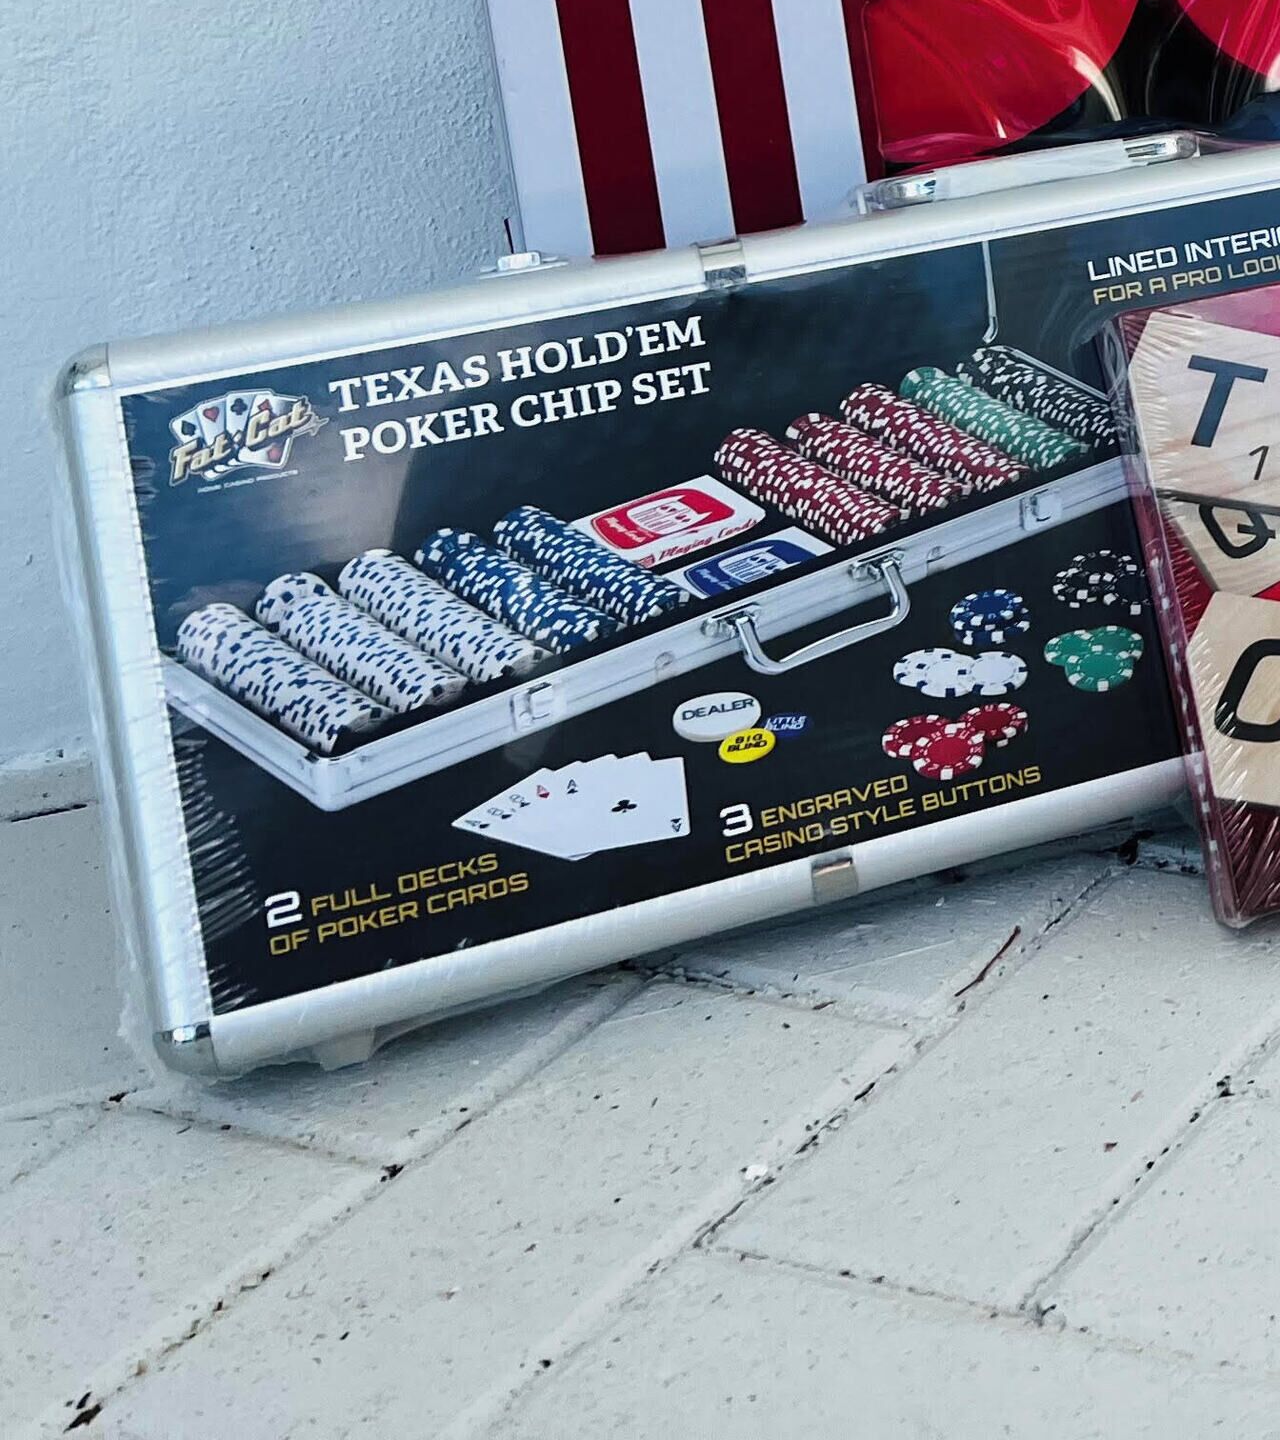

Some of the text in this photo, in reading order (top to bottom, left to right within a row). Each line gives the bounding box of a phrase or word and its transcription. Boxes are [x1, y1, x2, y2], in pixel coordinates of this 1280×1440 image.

[1087, 246, 1178, 281] LINED
[1093, 281, 1144, 305] FOR
[1149, 277, 1167, 294] A
[1172, 266, 1223, 291] PRO
[328, 315, 706, 412] TEXAS HOLD'EM
[340, 361, 712, 462] POKER CHIP SET
[1188, 354, 1269, 448] T
[171, 398, 313, 483] Fat Cat
[659, 517, 758, 560] Playing Cards
[682, 698, 754, 721] DEALER
[734, 733, 763, 745] BIG
[727, 740, 768, 753] BLIND
[720, 774, 908, 837] 3 ENGRAVED
[725, 766, 1042, 864] CASINO STYLE BUTTONS
[264, 853, 498, 928] 2 FULL DECKS
[270, 872, 529, 956] OF POKER CARDS
